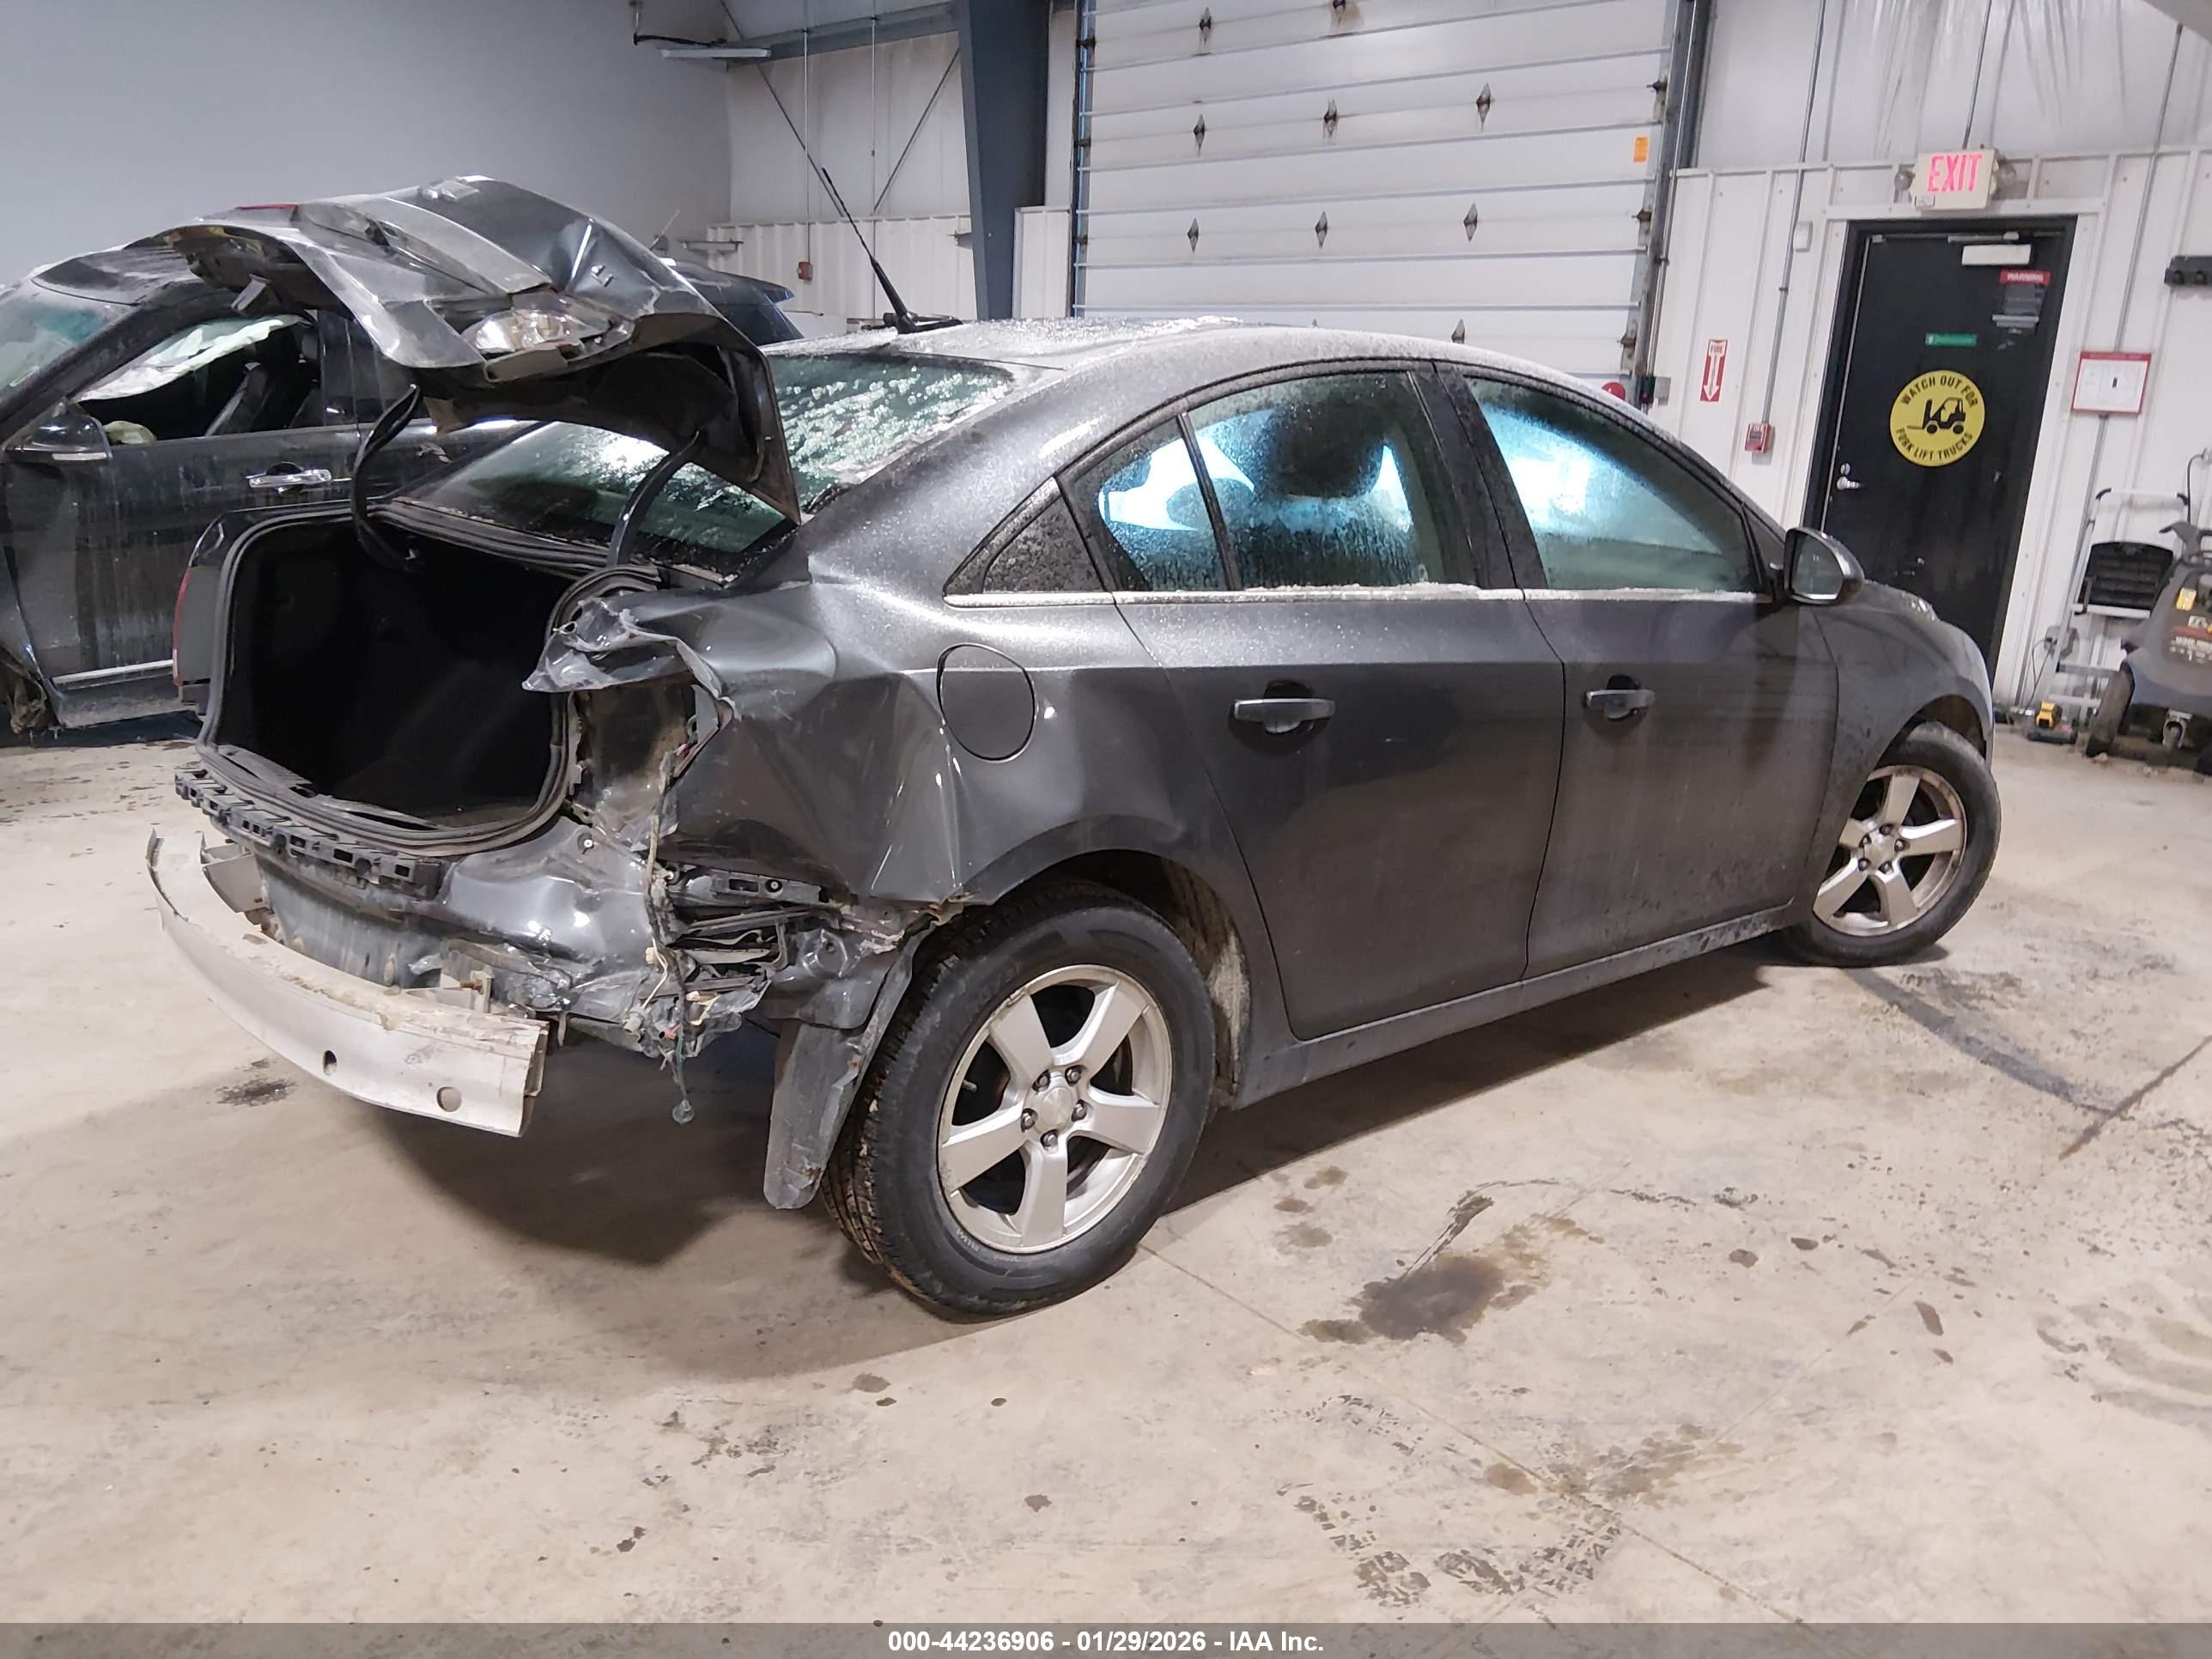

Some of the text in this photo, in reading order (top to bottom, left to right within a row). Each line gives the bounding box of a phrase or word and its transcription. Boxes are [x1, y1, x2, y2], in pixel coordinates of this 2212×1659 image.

[1927, 153, 1984, 192] EXIT
[1901, 374, 1978, 408] WATCH OUT FOR
[1896, 428, 1973, 461] FORK LIFT TRUCKS
